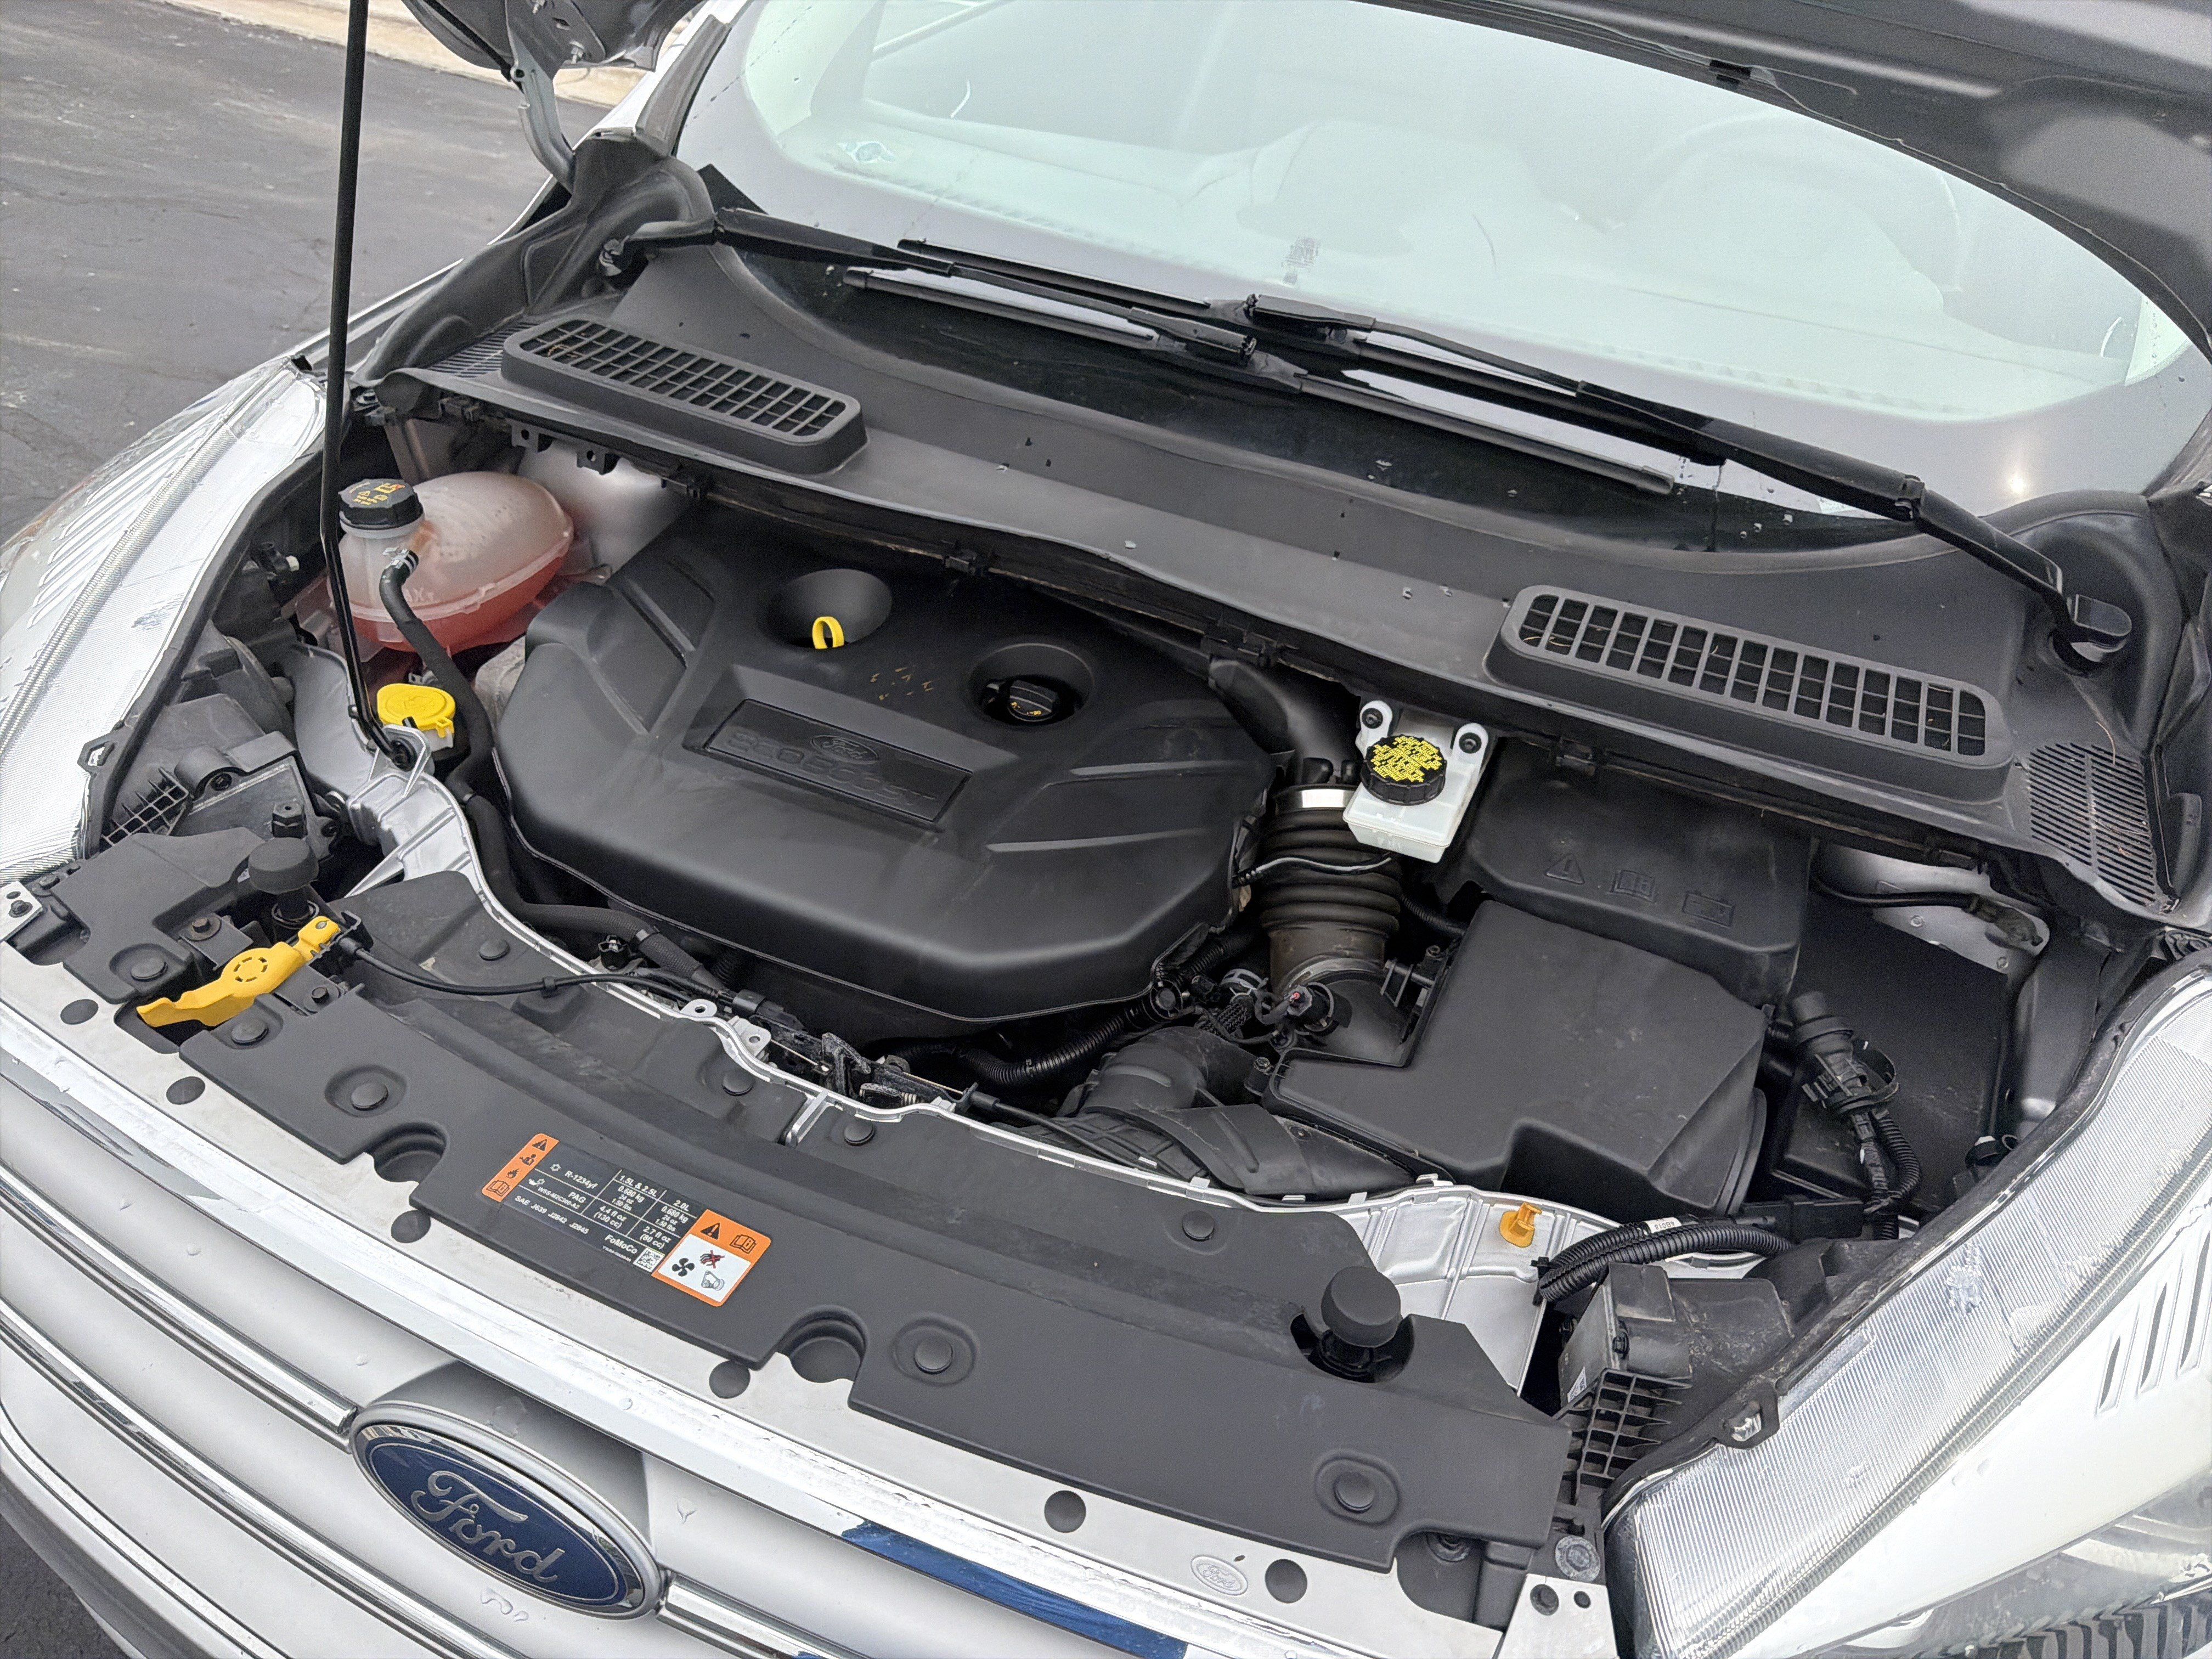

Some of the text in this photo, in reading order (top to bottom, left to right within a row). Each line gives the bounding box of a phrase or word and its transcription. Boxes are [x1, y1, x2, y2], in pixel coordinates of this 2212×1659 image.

[820, 737, 869, 761] Ford
[565, 1170, 598, 1189] R-1234yf
[619, 1175, 634, 1186] 1.5L
[641, 1186, 657, 1197] 2.5L
[568, 1192, 586, 1203] PAG
[612, 1198, 623, 1206] 1.50
[618, 1186, 645, 1203] 0.680 kg
[515, 1195, 531, 1206] SAE
[531, 1204, 548, 1214] J639
[600, 1206, 612, 1214] 4.4
[673, 1200, 690, 1211] 2.0L
[594, 1211, 622, 1229] (130 cc)
[655, 1219, 667, 1227] 1.50
[661, 1206, 689, 1223] 0.680 kg
[643, 1226, 657, 1234] 2.7
[605, 1234, 637, 1254] FoMoCo
[640, 1234, 665, 1249] (80 cc)
[410, 1470, 566, 1583] Ford
[1203, 1565, 1235, 1588] Ford
